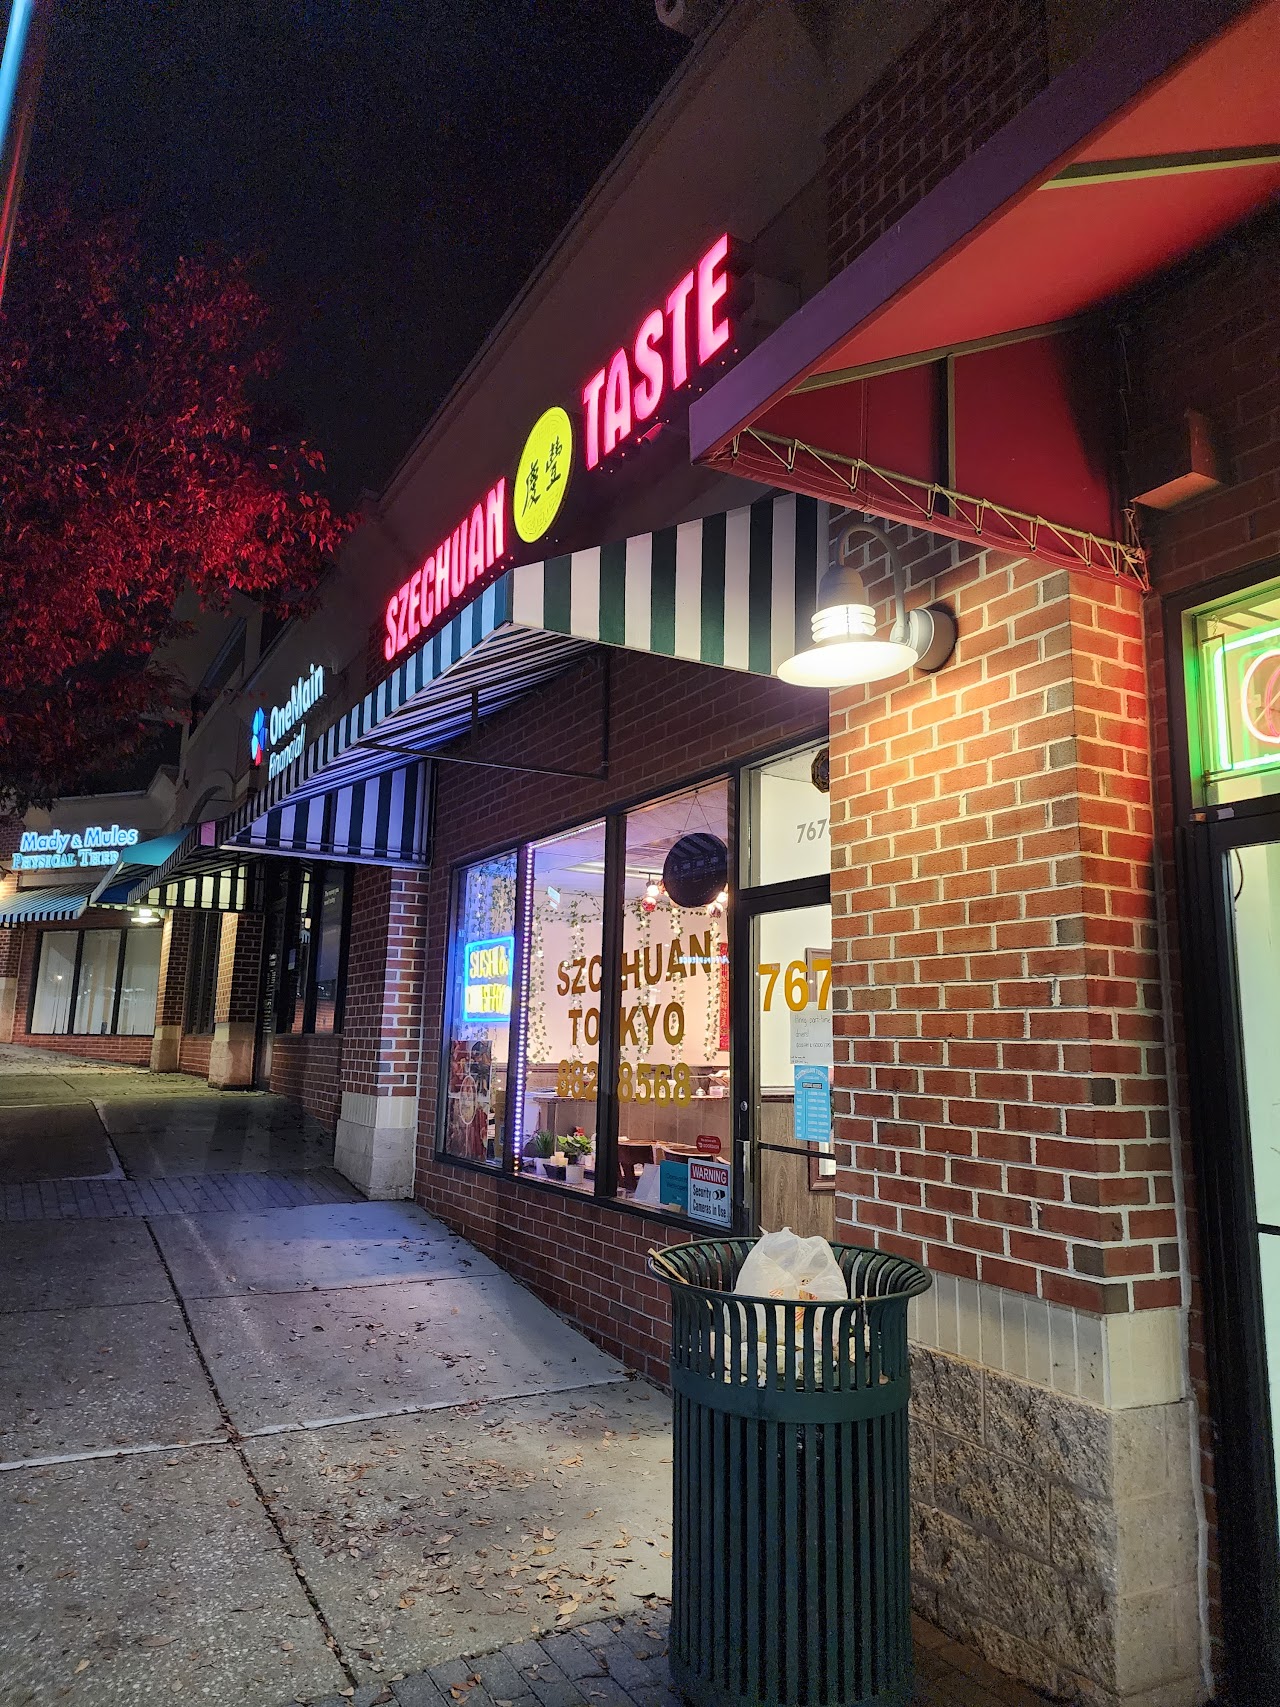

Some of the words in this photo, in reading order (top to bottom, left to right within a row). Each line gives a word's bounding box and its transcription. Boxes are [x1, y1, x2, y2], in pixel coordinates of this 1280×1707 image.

[384, 477, 506, 661] SZECHUAN
[583, 233, 731, 470] TASTE
[270, 663, 324, 746] OneMain
[268, 723, 306, 782] Financial
[20, 829, 71, 853] Mady
[71, 834, 83, 849] &
[84, 824, 139, 847] Mules
[758, 958, 832, 1011] 767
[568, 1001, 685, 1046] TOKYO
[692, 1165, 727, 1184] WARNING
[693, 1184, 711, 1201] Security
[693, 1199, 711, 1215] Cameras
[717, 1205, 727, 1218] Use
